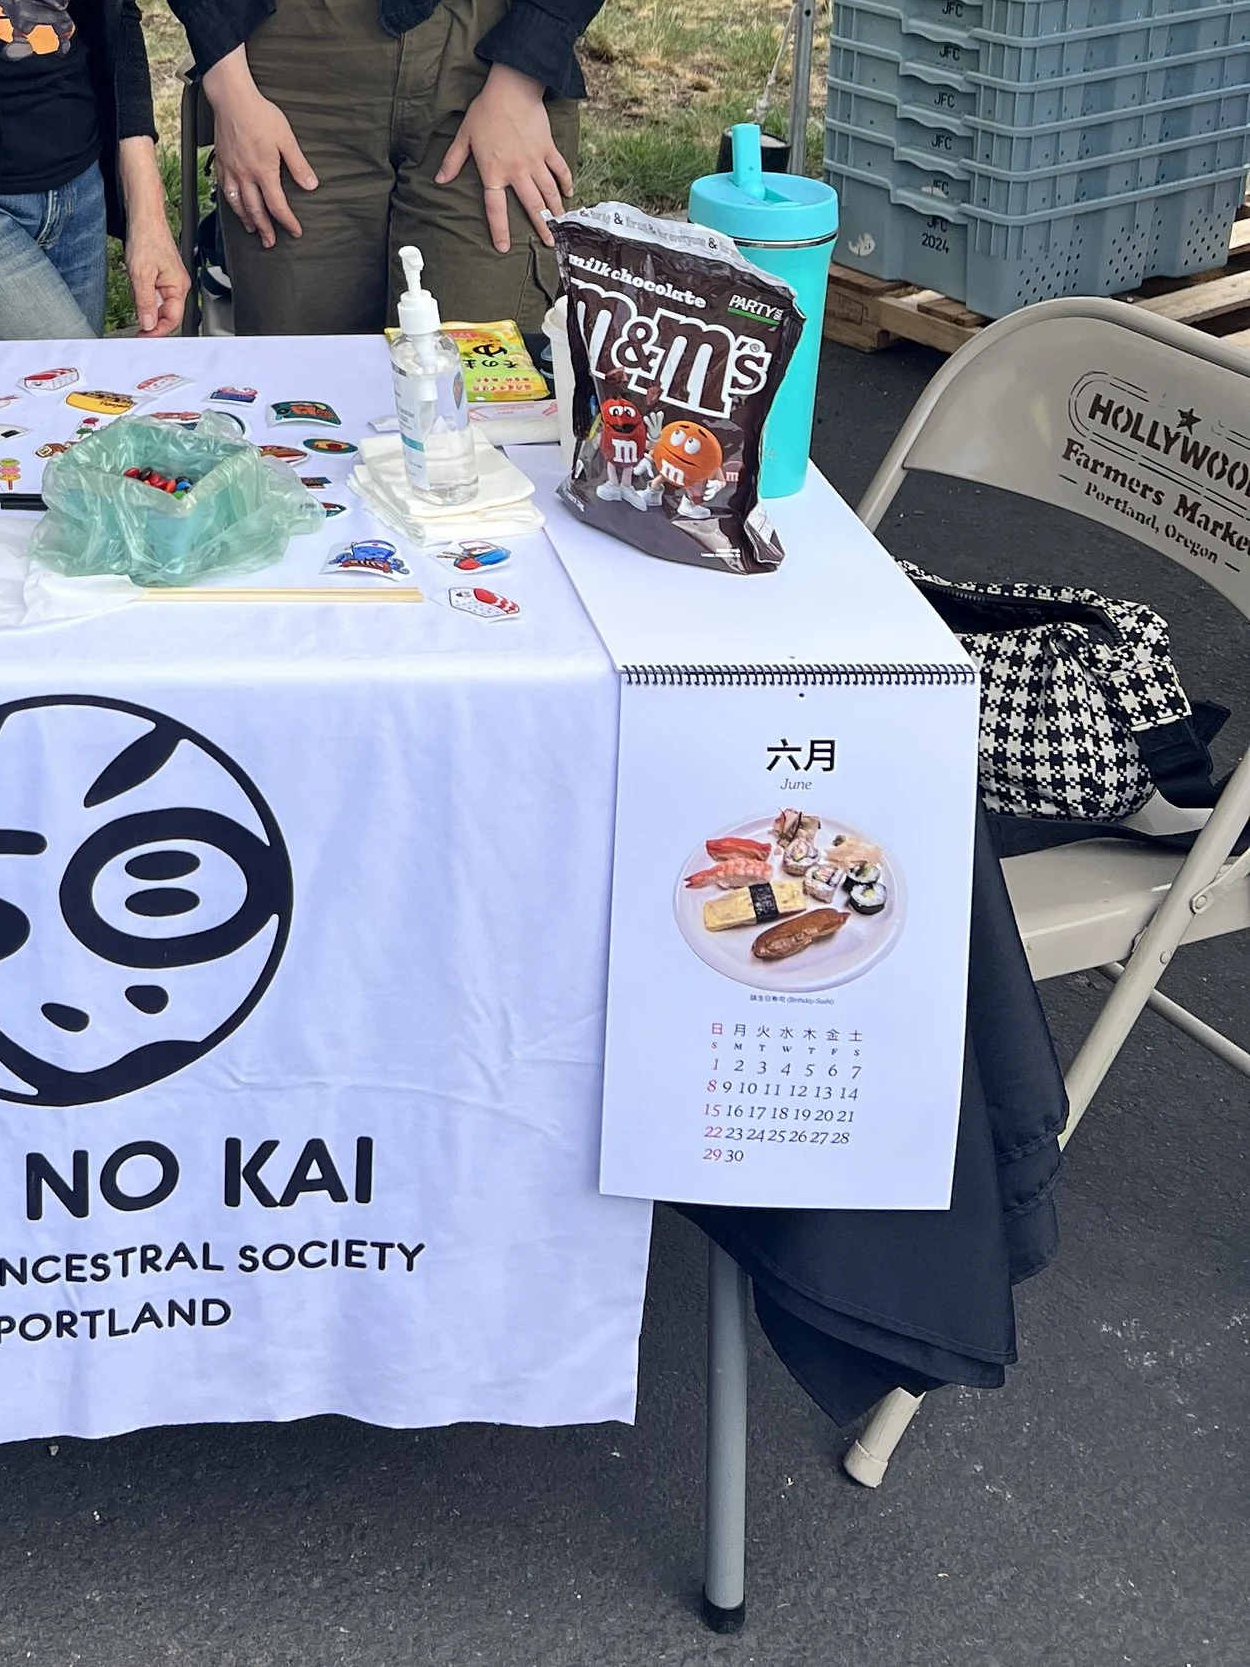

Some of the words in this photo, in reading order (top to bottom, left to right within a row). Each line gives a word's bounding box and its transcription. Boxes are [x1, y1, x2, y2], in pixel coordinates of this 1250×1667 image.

[941, 1, 964, 19] JFC
[938, 44, 961, 62] JFC
[933, 92, 955, 109] JFC
[930, 134, 953, 151] JFC
[614, 212, 624, 225] &
[708, 237, 718, 250] &
[927, 215, 948, 233] JFC
[921, 233, 950, 254] 2024
[568, 253, 612, 278] milk
[611, 268, 707, 309] chocolate
[729, 294, 777, 318] PARTY
[472, 344, 508, 358] ゆ
[463, 358, 519, 370] そのま
[612, 439, 639, 463] m
[1087, 392, 1250, 498] HOLLYWOO
[660, 459, 685, 486] m
[1061, 438, 1166, 506] Farmers
[1173, 493, 1250, 556] Marke
[1084, 482, 1160, 533] Portland,
[1165, 523, 1218, 564] Oregon
[766, 738, 835, 771] 六月
[780, 778, 812, 790] June
[711, 1023, 723, 1035] 日
[734, 1023, 746, 1037] 月
[756, 1025, 771, 1038] 火
[779, 1027, 794, 1039] 水
[803, 1028, 817, 1040] 木
[826, 1028, 840, 1041] 金
[849, 1030, 863, 1042] 土
[759, 1044, 766, 1052] T
[853, 1049, 860, 1057] S
[712, 1058, 719, 1071] 1
[734, 1059, 744, 1072] 2
[757, 1061, 767, 1075] 3
[780, 1063, 791, 1076] 4
[804, 1064, 815, 1077] 5
[828, 1064, 838, 1077] 6
[851, 1066, 862, 1079] 7
[707, 1079, 718, 1092] 8
[722, 1081, 732, 1093] 9
[739, 1082, 757, 1095] 10
[764, 1083, 780, 1096] 11
[789, 1085, 808, 1097] 12
[814, 1086, 832, 1100] 13
[840, 1087, 858, 1101] 14
[703, 1103, 722, 1117] 15
[726, 1105, 743, 1117] 16
[748, 1106, 766, 1120] 17
[771, 1107, 789, 1119] 18
[794, 1109, 811, 1121] 19
[814, 1110, 834, 1122] 20
[837, 1110, 854, 1123] 21
[704, 1126, 723, 1138] 22
[725, 1127, 743, 1141] 23
[746, 1128, 765, 1142] 24
[767, 1129, 787, 1143] 25
[789, 1130, 807, 1143] 26
[810, 1132, 829, 1145] 27
[830, 1132, 850, 1144] 28
[703, 1148, 722, 1161] 29
[724, 1149, 744, 1163] 30
[26, 1140, 180, 1221] NO
[224, 1136, 373, 1207] KAI
[238, 1238, 426, 1273] SOCIETY
